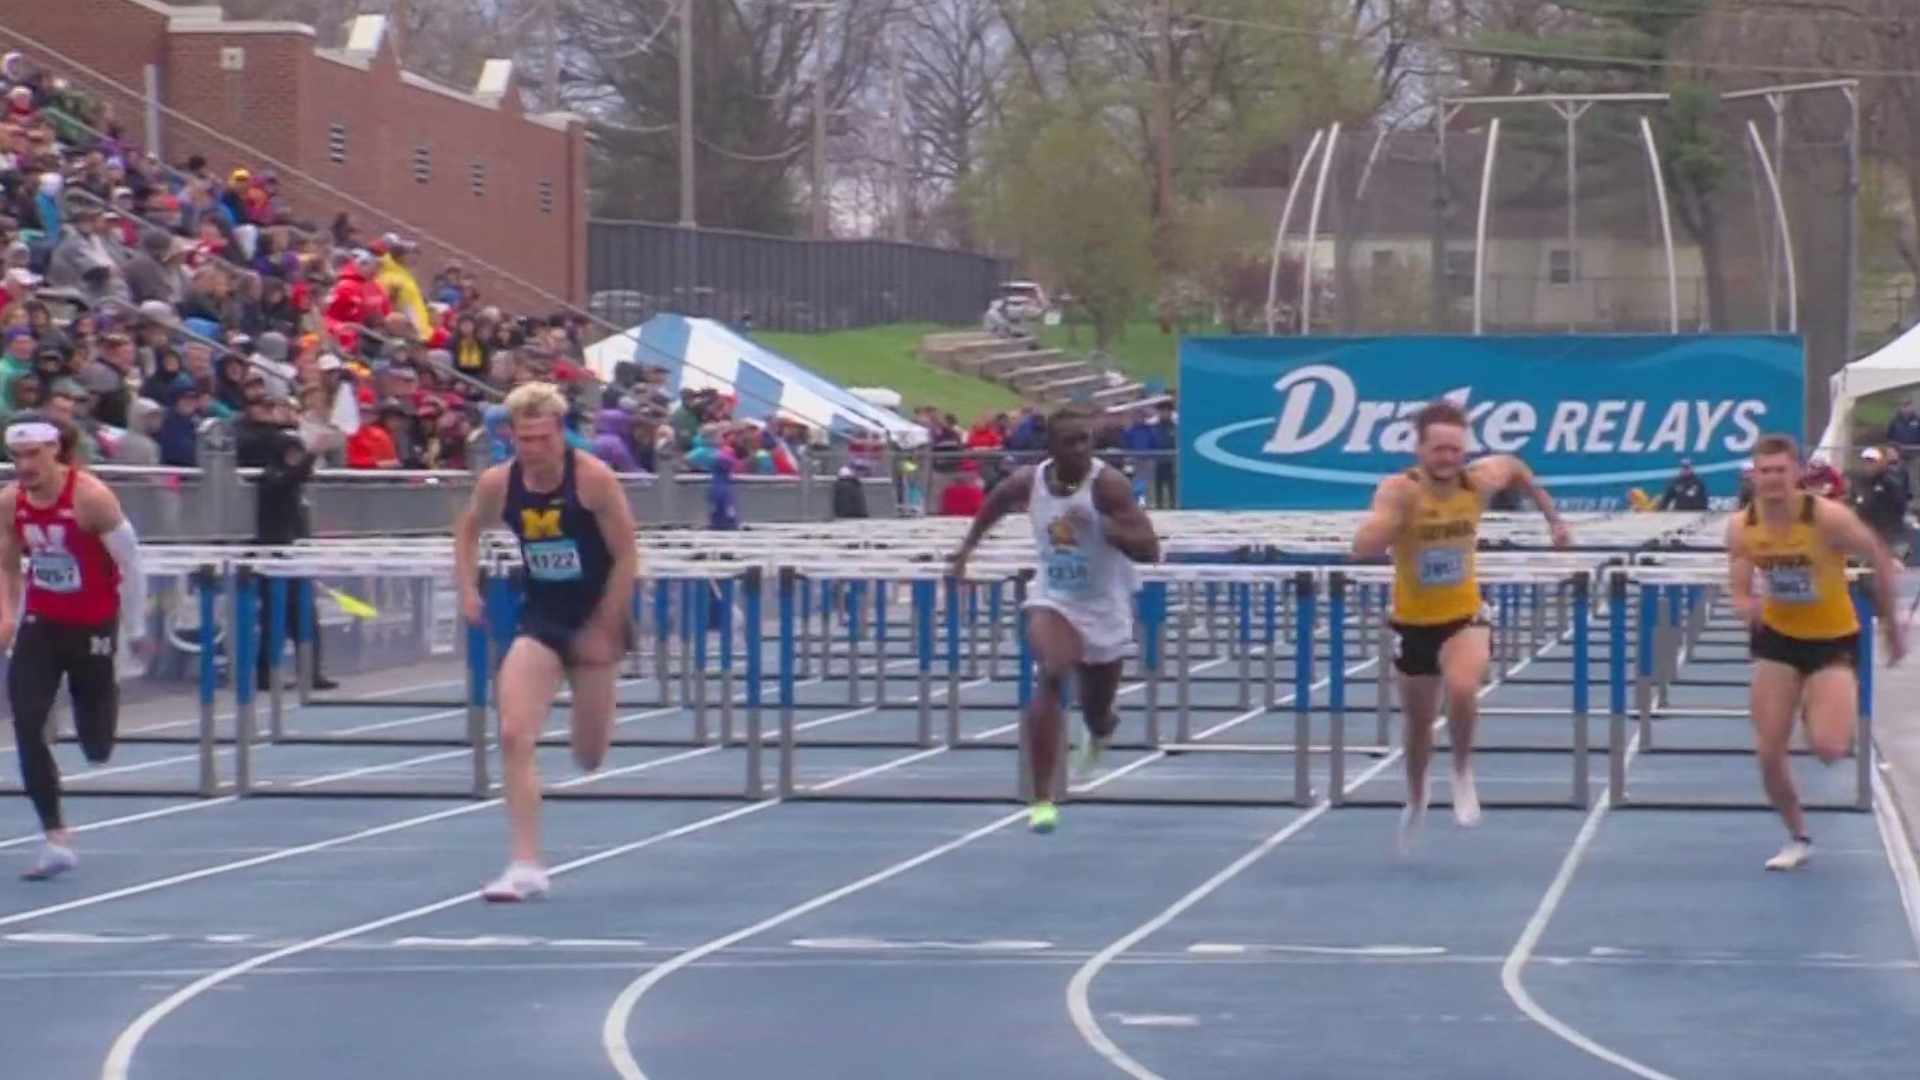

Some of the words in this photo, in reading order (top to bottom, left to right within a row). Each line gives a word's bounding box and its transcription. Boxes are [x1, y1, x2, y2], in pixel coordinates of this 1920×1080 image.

[1263, 364, 1537, 454] Drake
[1544, 400, 1767, 453] RELAYS
[23, 523, 67, 554] N
[521, 509, 562, 539] M
